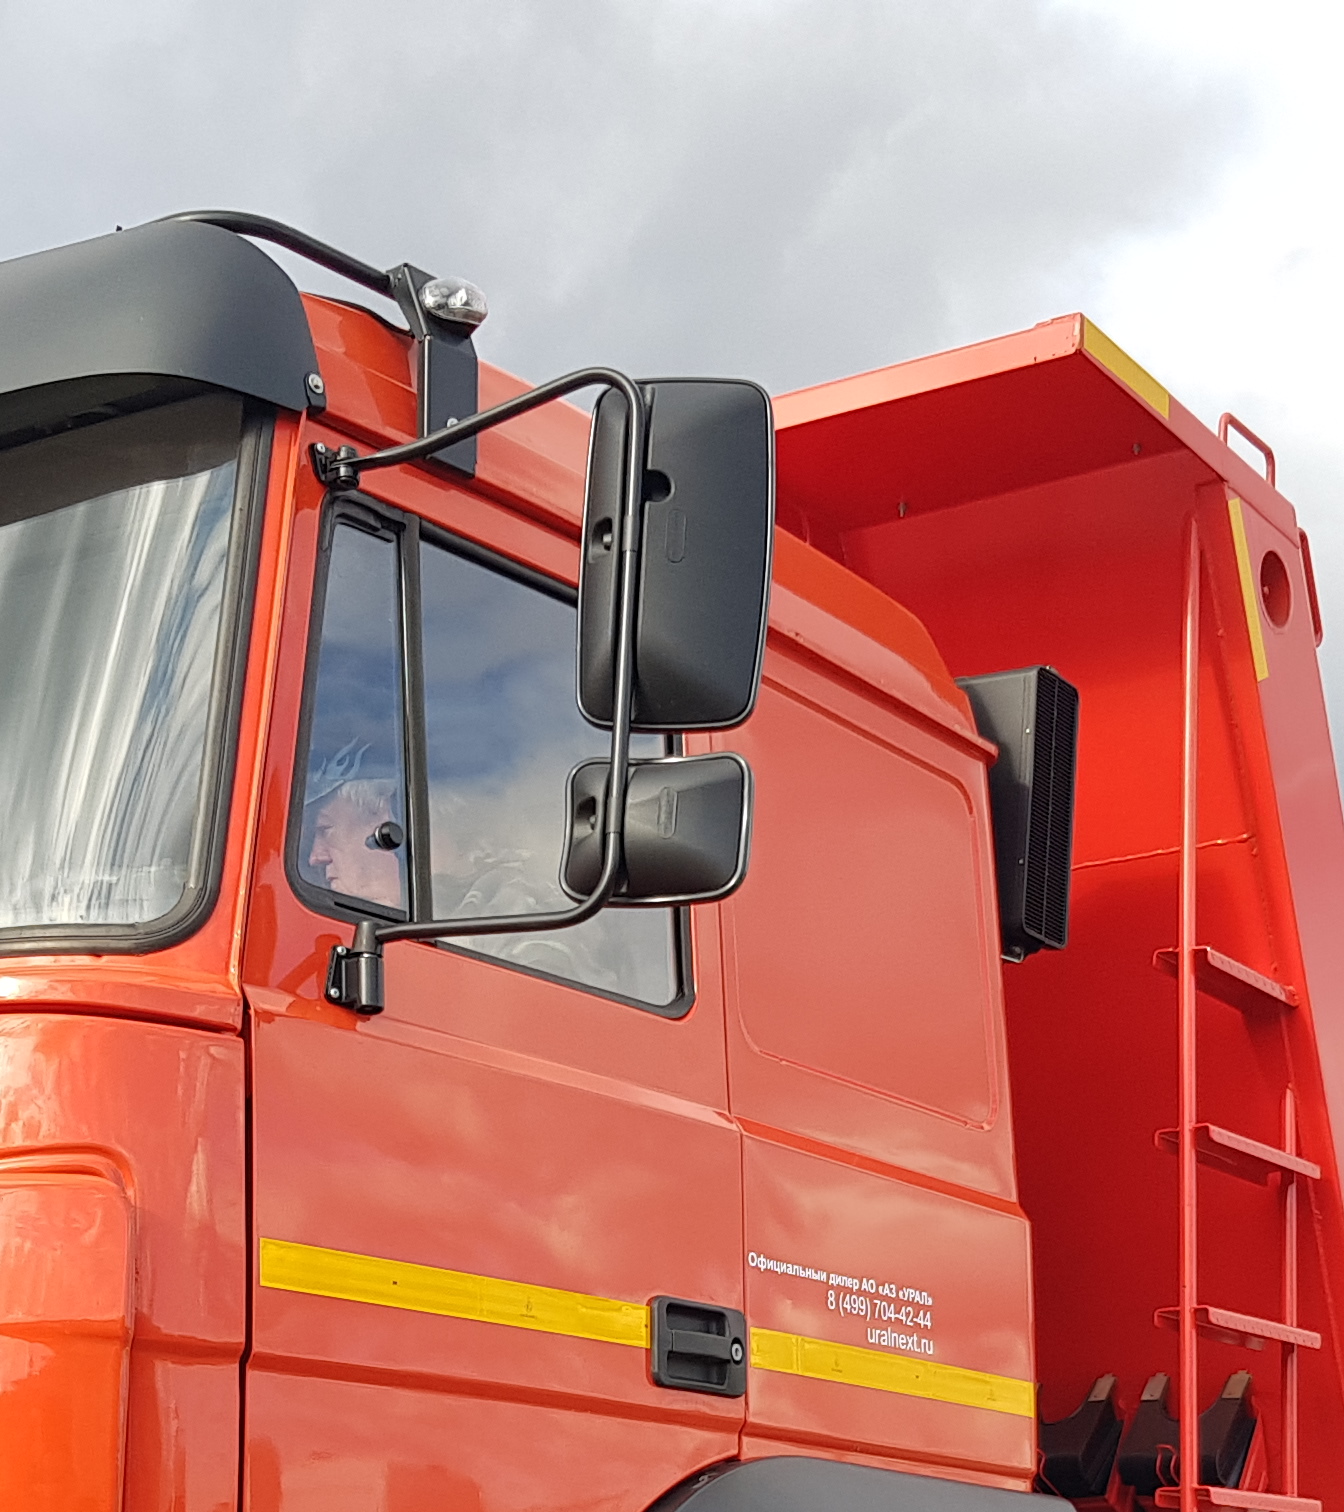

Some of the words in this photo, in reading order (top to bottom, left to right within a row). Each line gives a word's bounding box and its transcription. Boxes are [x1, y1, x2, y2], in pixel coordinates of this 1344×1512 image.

[828, 1273, 860, 1292] дилер
[861, 1277, 876, 1294] АО
[878, 1282, 897, 1298] «АЗ
[898, 1287, 933, 1306] «УРАЛ»
[827, 1289, 836, 1310] 8
[839, 1291, 871, 1322] (499)
[873, 1299, 932, 1330] 704-42-44
[867, 1327, 934, 1355] uralnext.ru
